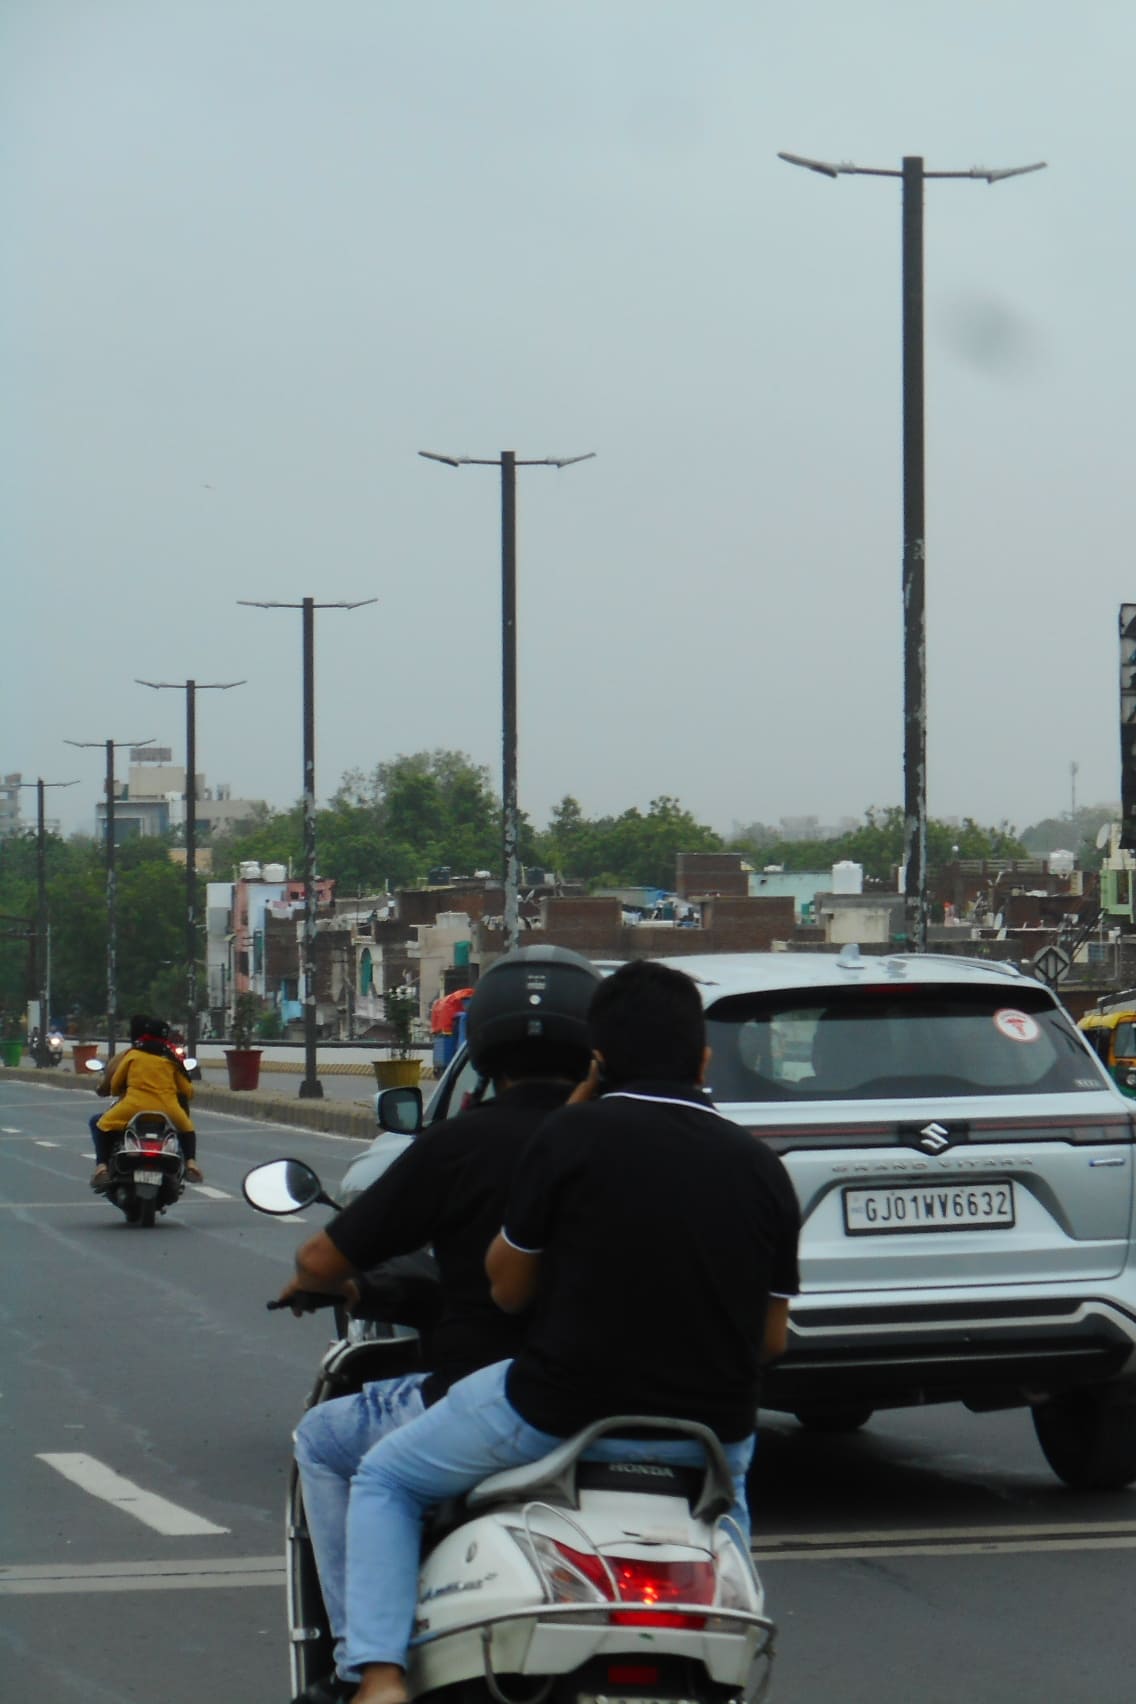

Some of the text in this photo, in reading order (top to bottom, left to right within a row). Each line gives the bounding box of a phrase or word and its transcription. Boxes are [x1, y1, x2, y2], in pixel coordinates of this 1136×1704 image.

[832, 1159, 1033, 1173] GRAND VITARA
[865, 1191, 1008, 1221] GJ01WV6632
[608, 1463, 674, 1477] HONDA
